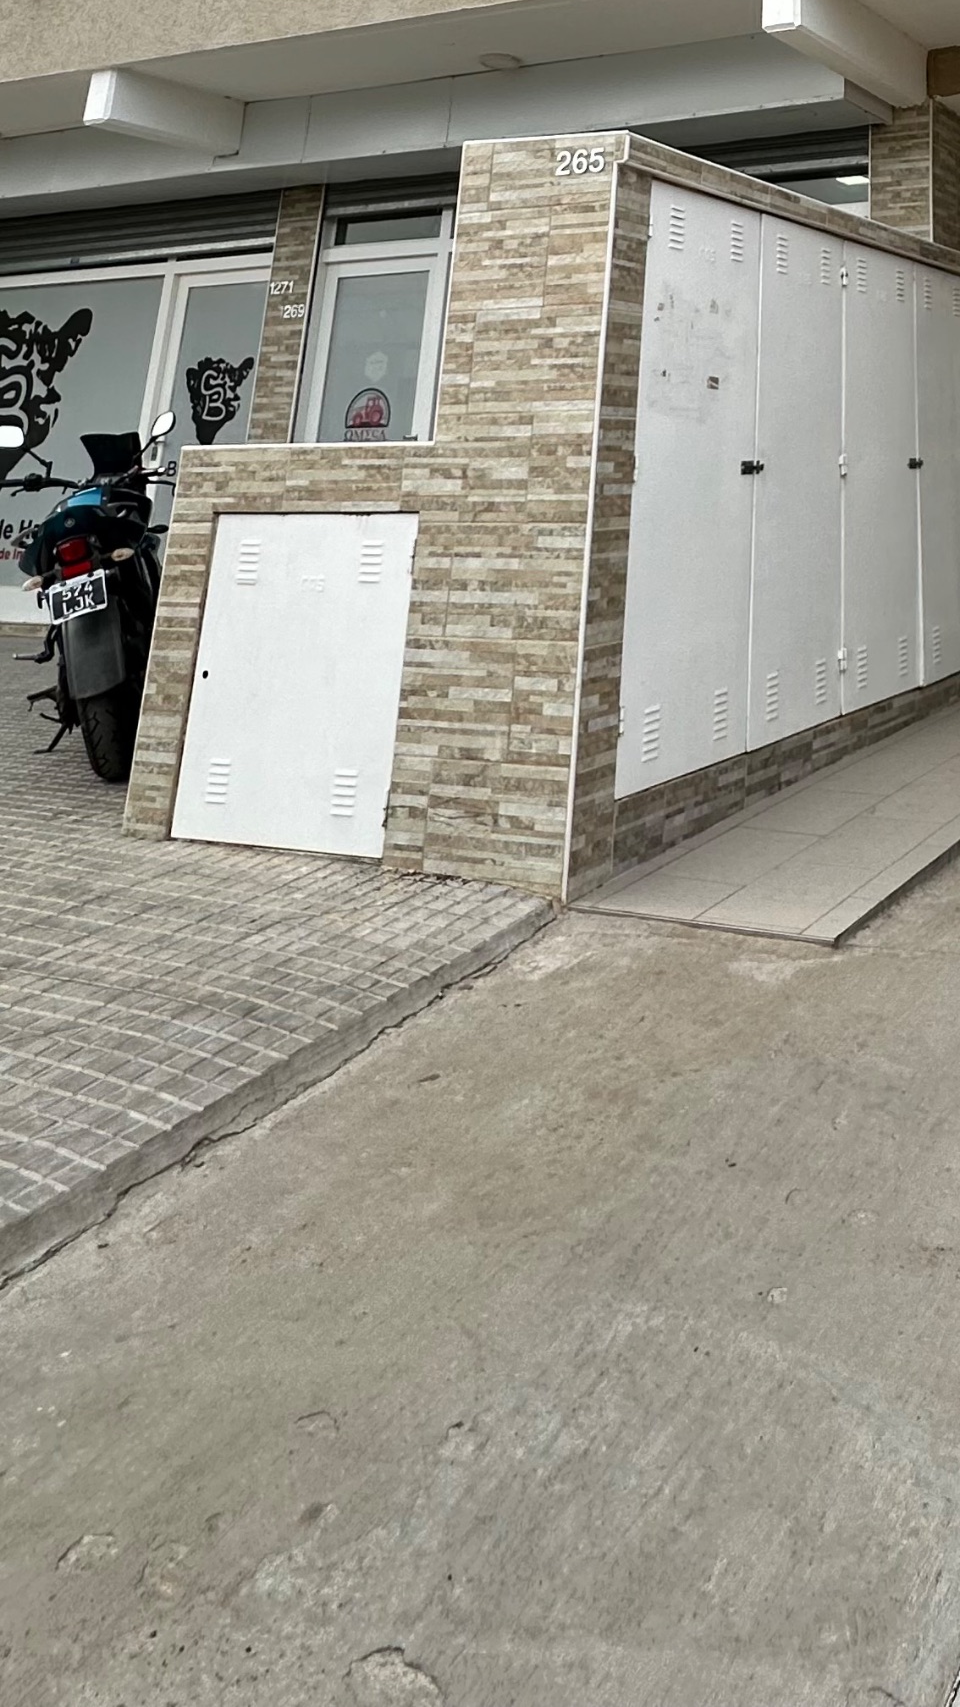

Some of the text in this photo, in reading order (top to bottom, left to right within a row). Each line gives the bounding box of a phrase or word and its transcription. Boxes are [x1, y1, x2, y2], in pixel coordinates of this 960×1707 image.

[555, 147, 605, 176] 265
[283, 304, 305, 319] 269
[61, 581, 93, 601] 574
[62, 592, 95, 615] LJK
